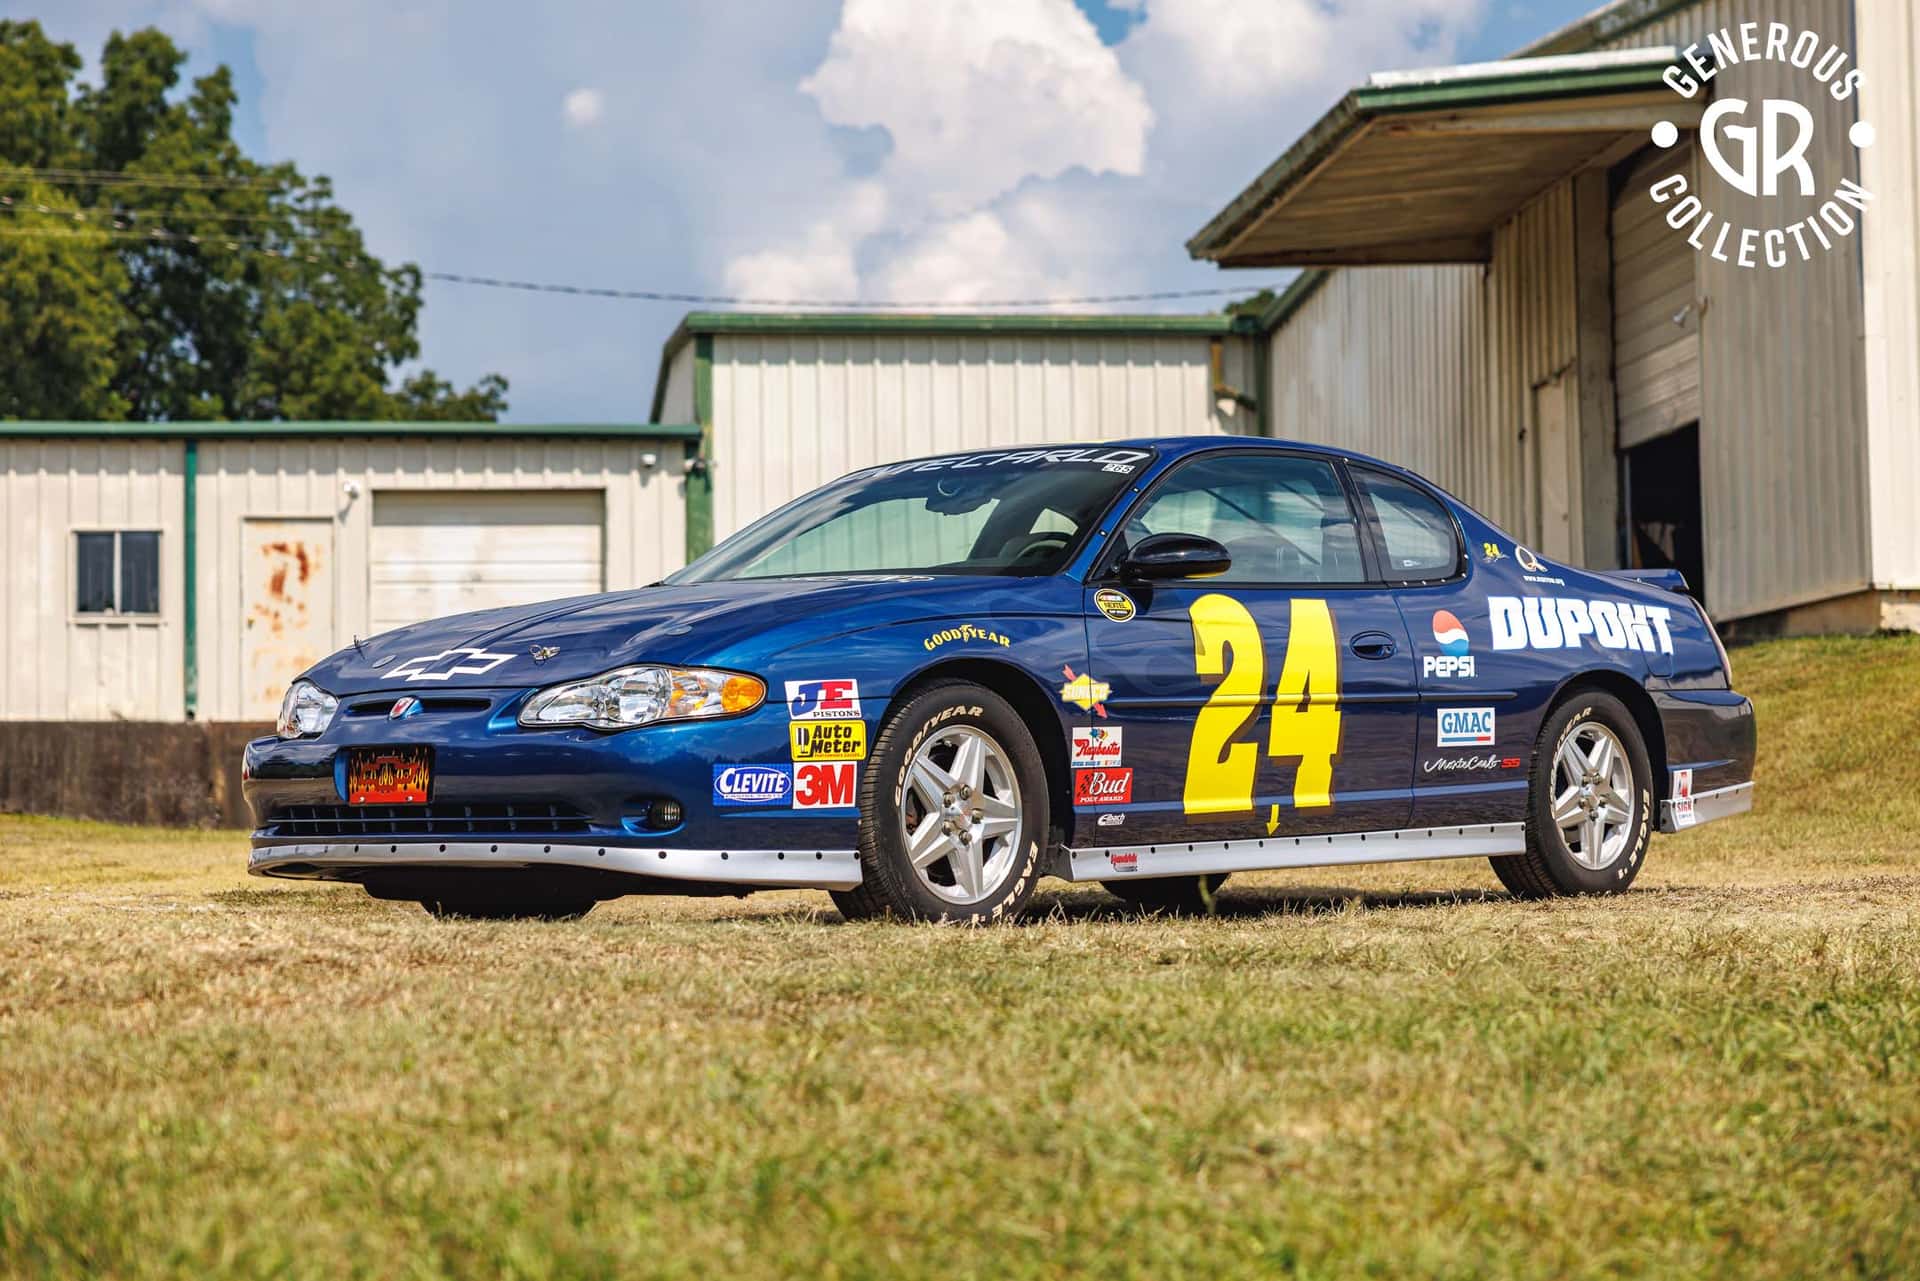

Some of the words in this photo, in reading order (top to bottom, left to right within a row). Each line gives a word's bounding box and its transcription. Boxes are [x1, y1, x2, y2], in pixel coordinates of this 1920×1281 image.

[1483, 543, 1500, 558] 24
[923, 624, 1011, 651] GOODYEAR
[1487, 596, 1674, 656] DUPONT
[1423, 656, 1475, 678] PEPSI
[791, 681, 853, 717] JE
[1183, 593, 1342, 815] 24
[812, 710, 861, 718] PISTONS
[1441, 711, 1492, 734] GMAC
[812, 725, 852, 739] Auto
[811, 739, 861, 753] Meter
[895, 705, 985, 807] GOODYEAR
[1501, 758, 1520, 768] SS
[719, 767, 785, 794] CLEVITE
[795, 763, 856, 806] 3M
[1089, 772, 1131, 796] Bud
[991, 840, 1039, 919] EAGLE
